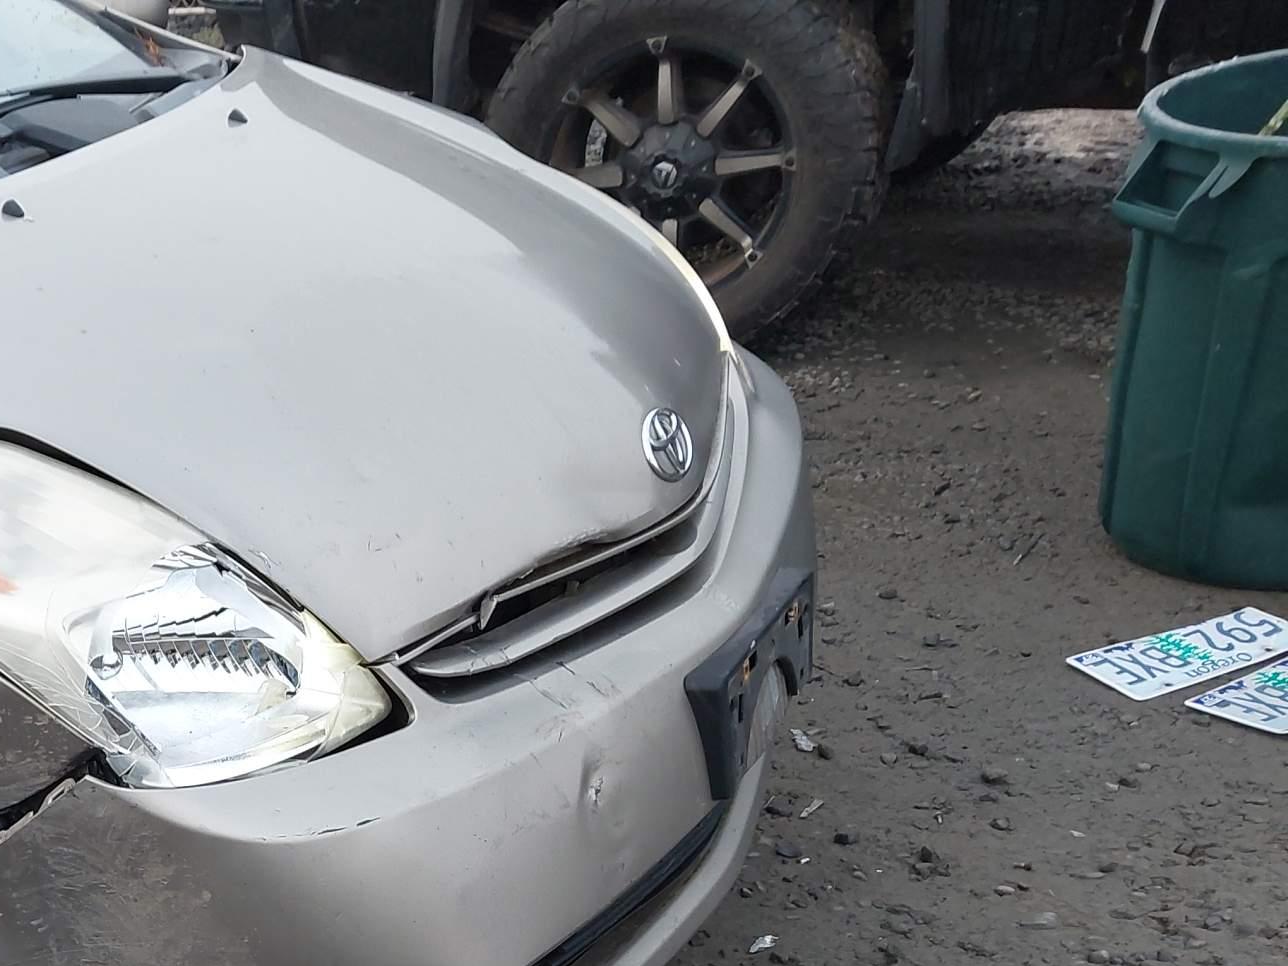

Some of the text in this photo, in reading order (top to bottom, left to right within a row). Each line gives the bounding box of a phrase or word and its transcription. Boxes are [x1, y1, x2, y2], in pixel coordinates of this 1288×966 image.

[1089, 611, 1283, 686] 592 BXE
[1185, 652, 1253, 678] Oregon
